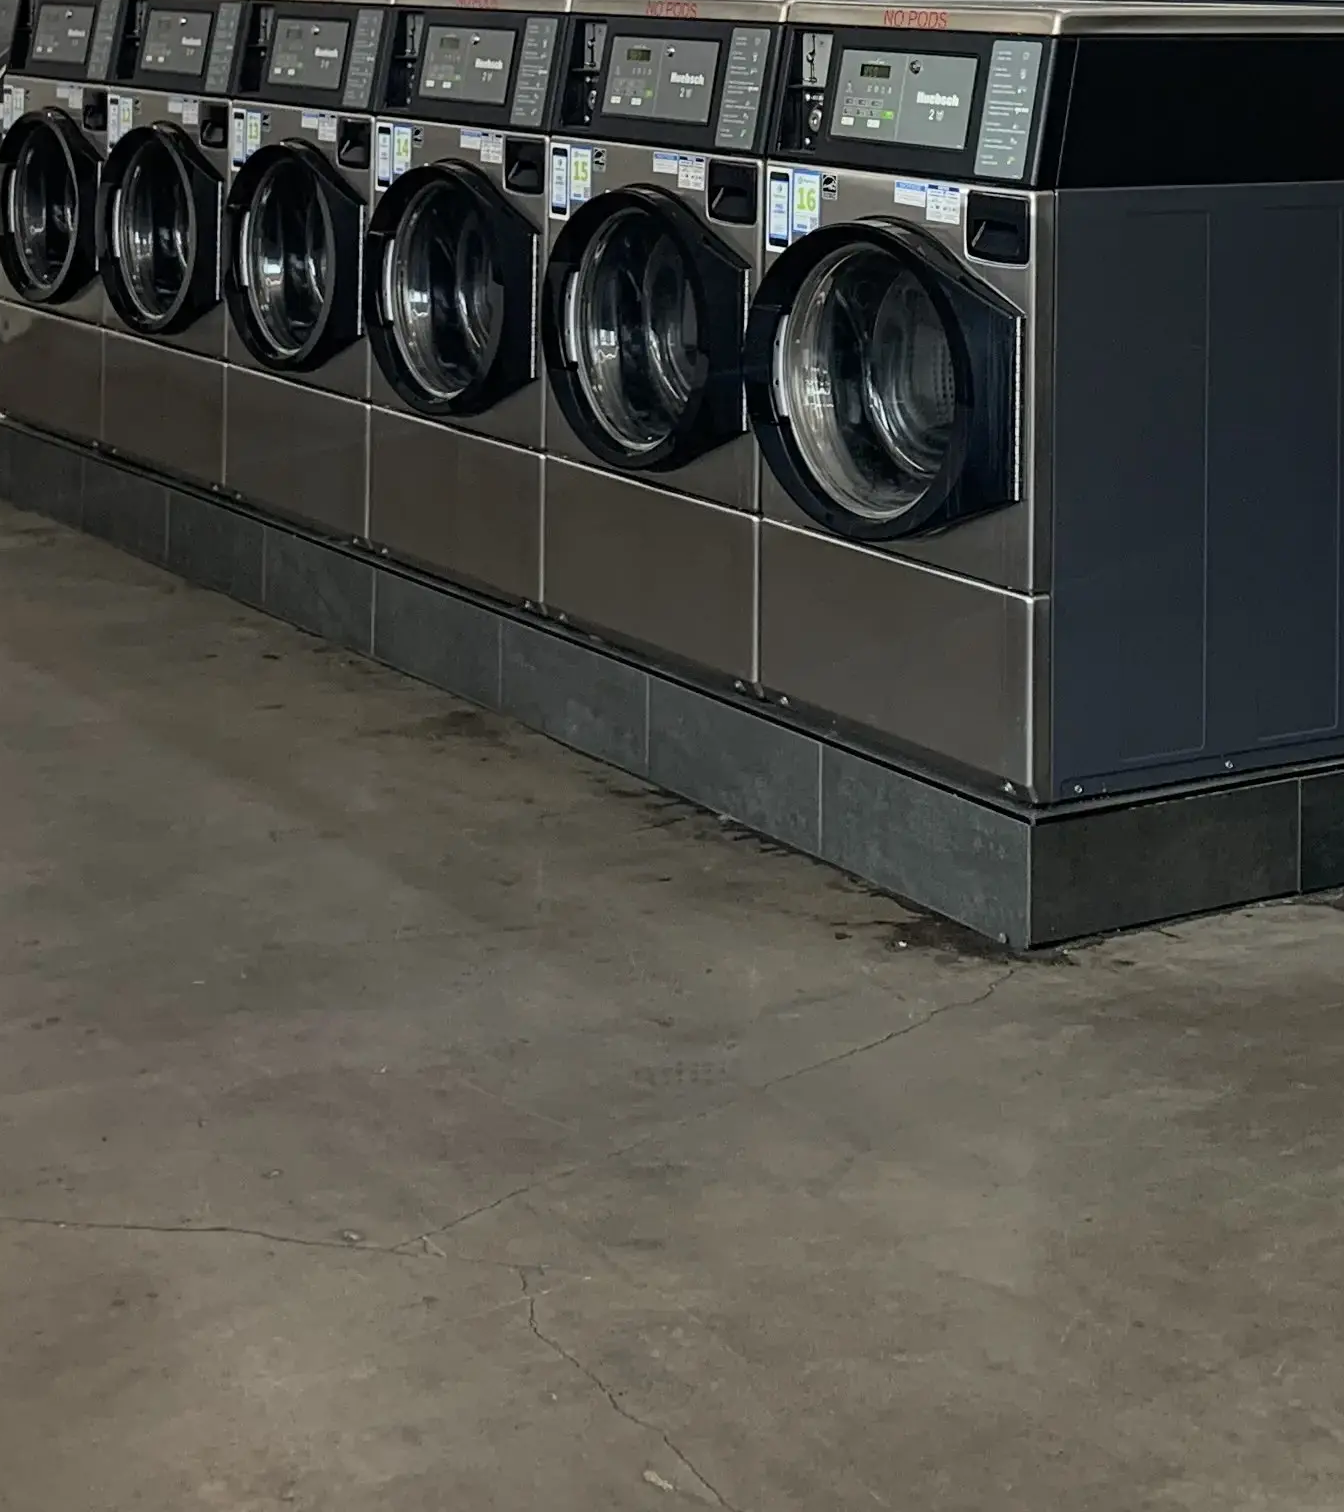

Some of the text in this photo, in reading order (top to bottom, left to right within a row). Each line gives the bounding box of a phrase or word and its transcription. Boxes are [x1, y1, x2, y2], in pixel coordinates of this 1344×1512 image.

[644, 0, 698, 19] NO PODS
[883, 9, 949, 29] NO PODS
[916, 91, 960, 108] Huebsch
[572, 160, 589, 182] 15
[796, 187, 817, 212] 16
